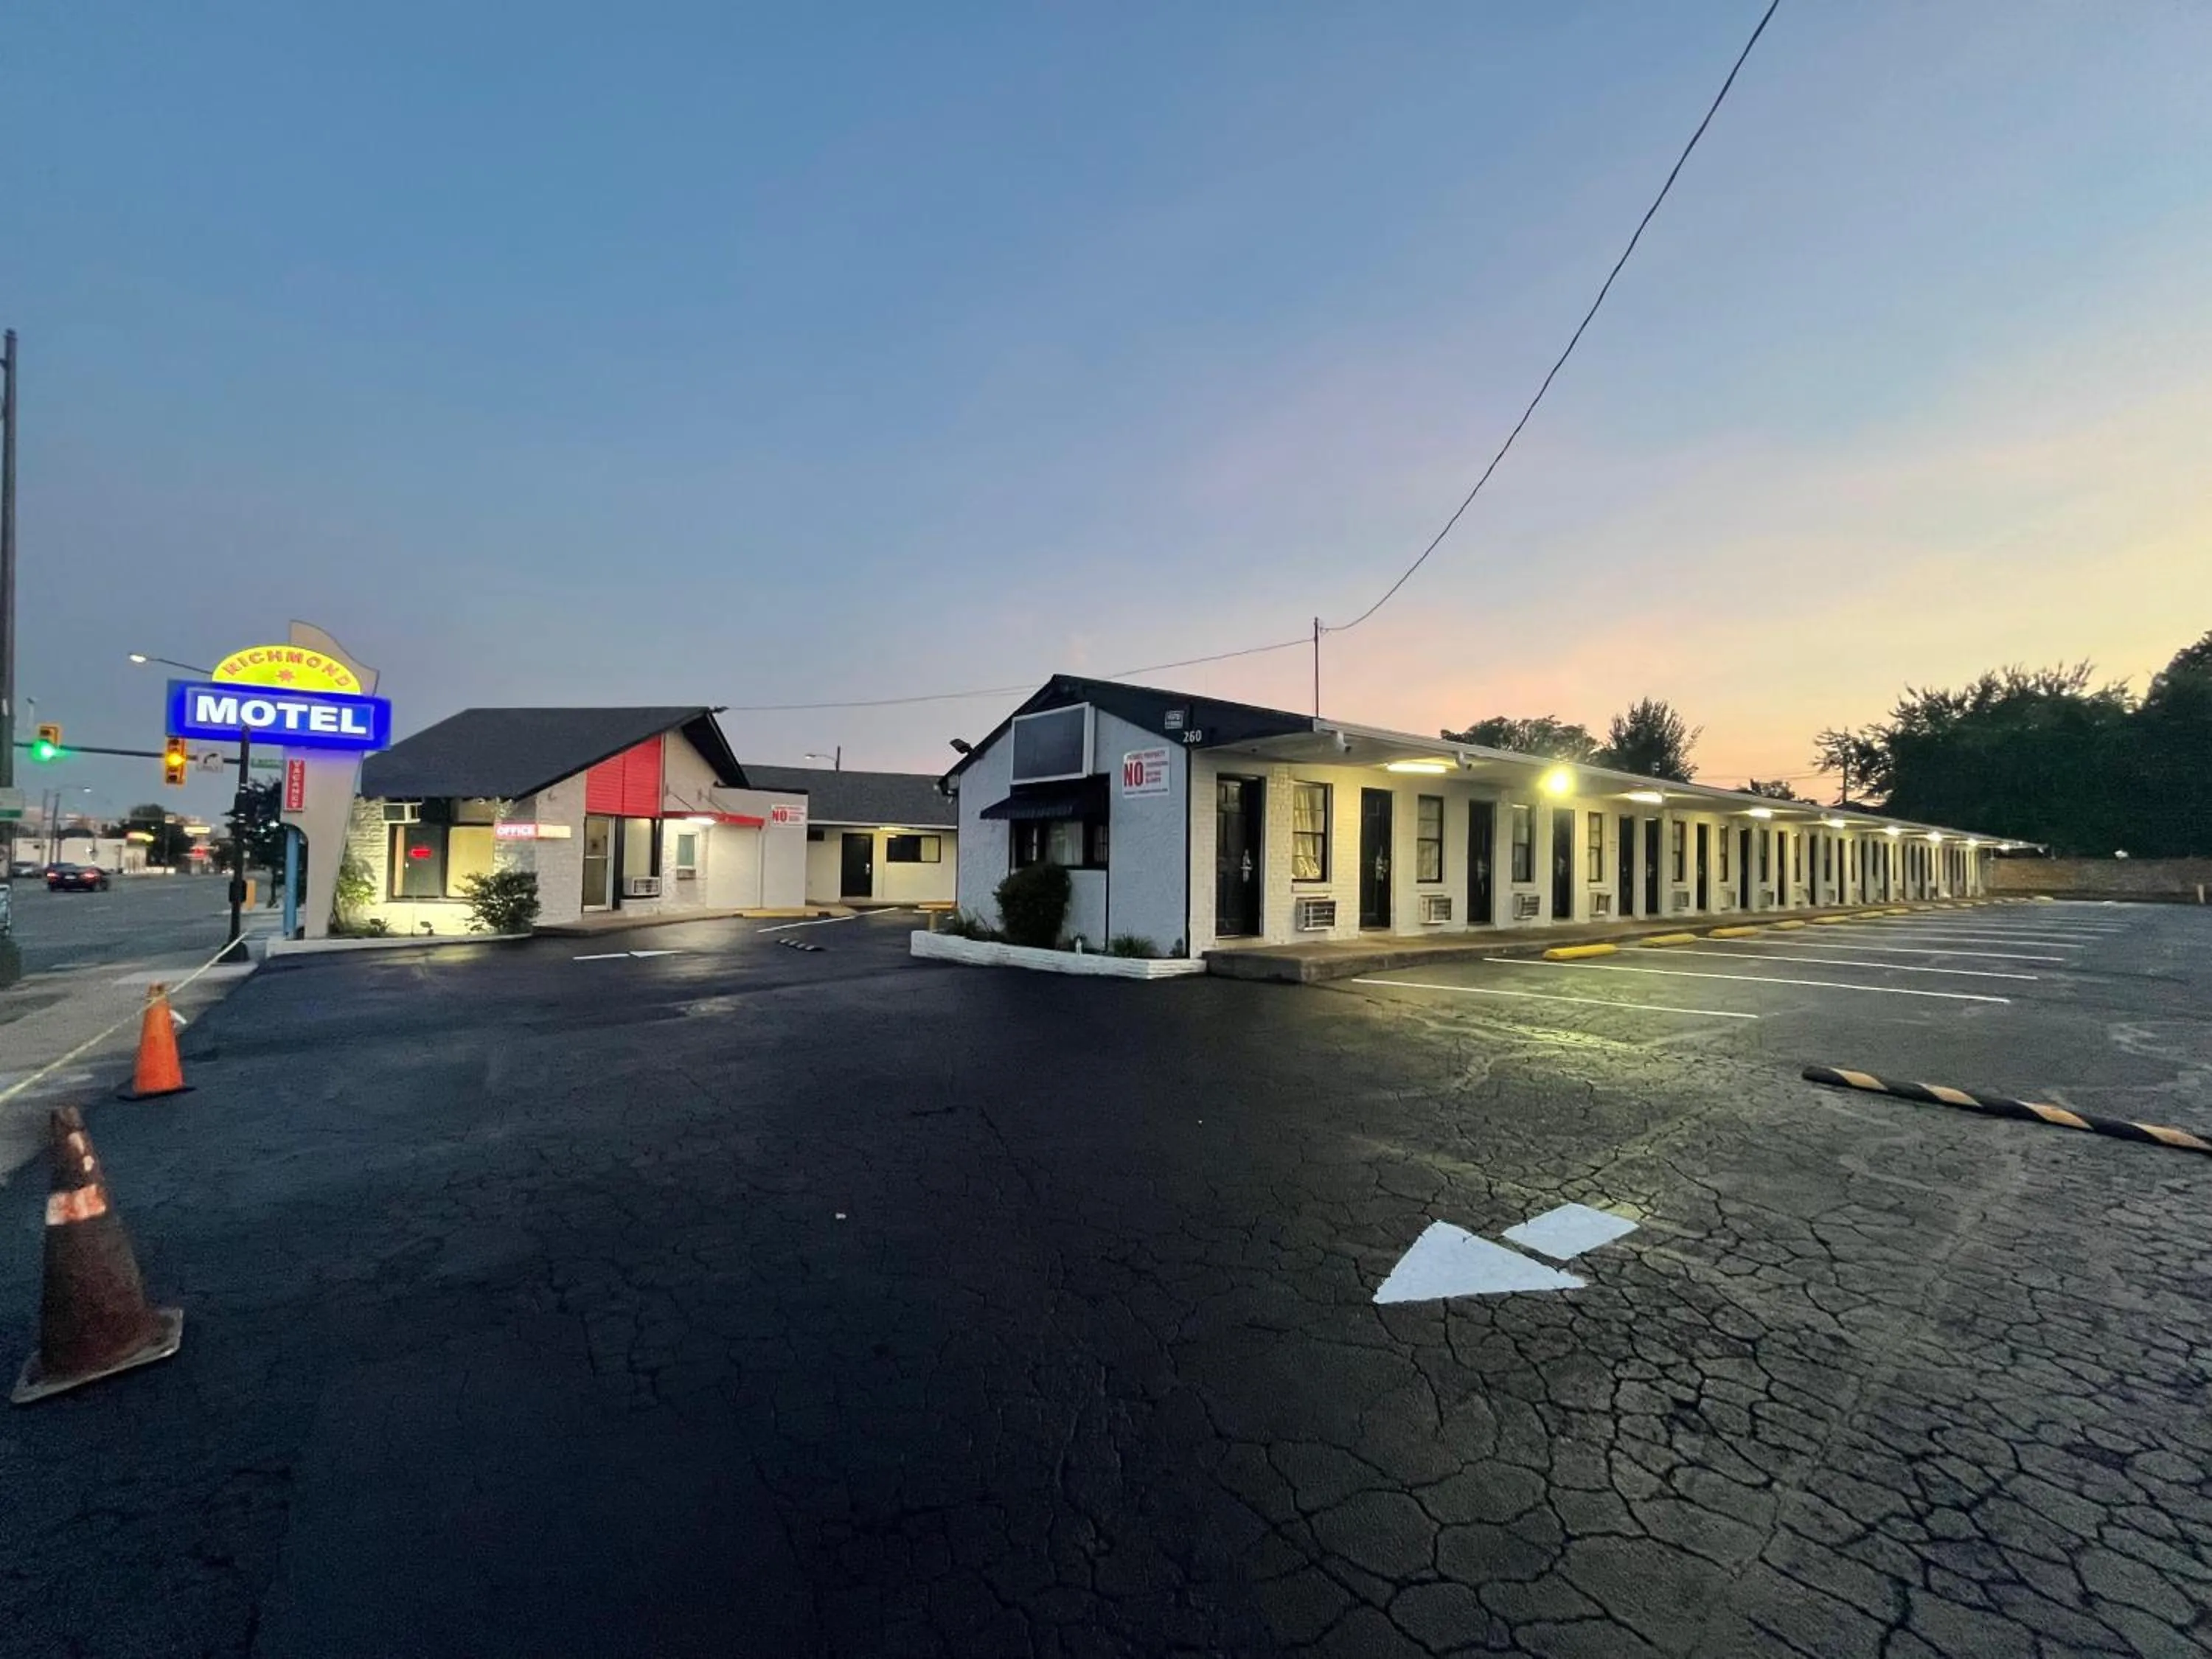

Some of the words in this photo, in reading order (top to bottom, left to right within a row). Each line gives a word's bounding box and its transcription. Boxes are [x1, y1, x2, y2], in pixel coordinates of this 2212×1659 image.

[223, 650, 350, 686] RICHMOND
[196, 695, 366, 734] MOTEL
[1183, 730, 1202, 742] 260
[1124, 761, 1144, 787] NO
[772, 810, 788, 823] NO
[496, 826, 535, 836] OFFICE
